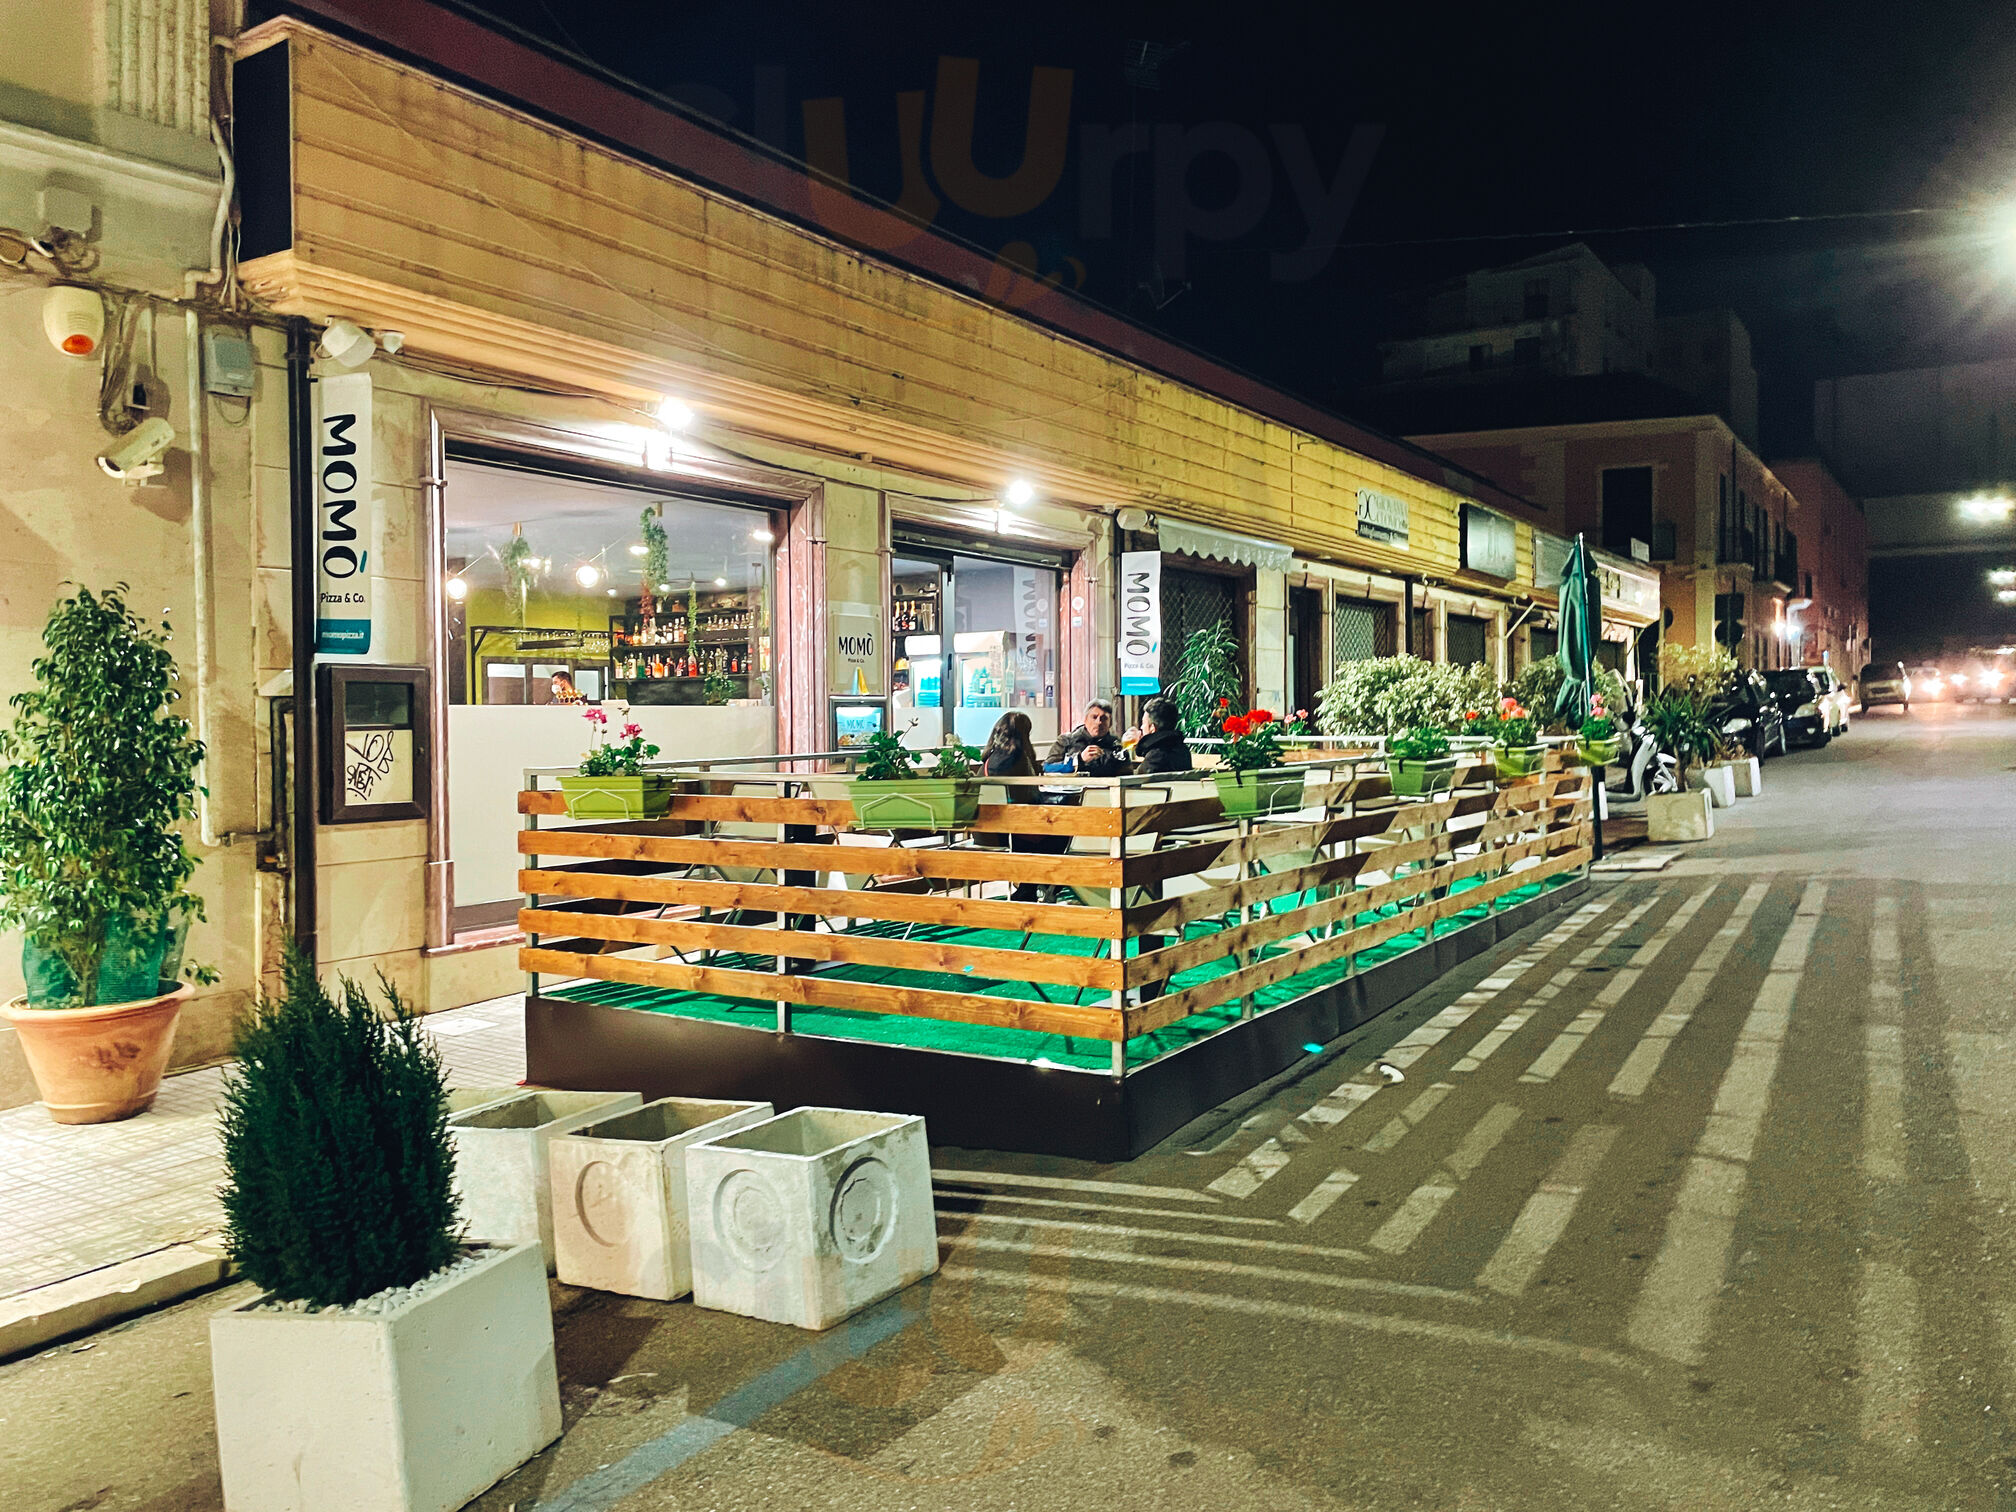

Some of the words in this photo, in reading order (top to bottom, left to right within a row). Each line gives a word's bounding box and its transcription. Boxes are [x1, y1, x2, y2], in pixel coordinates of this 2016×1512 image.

[320, 591, 342, 603] Pizza
[344, 593, 351, 603] &
[838, 632, 874, 656] MOMÒ
